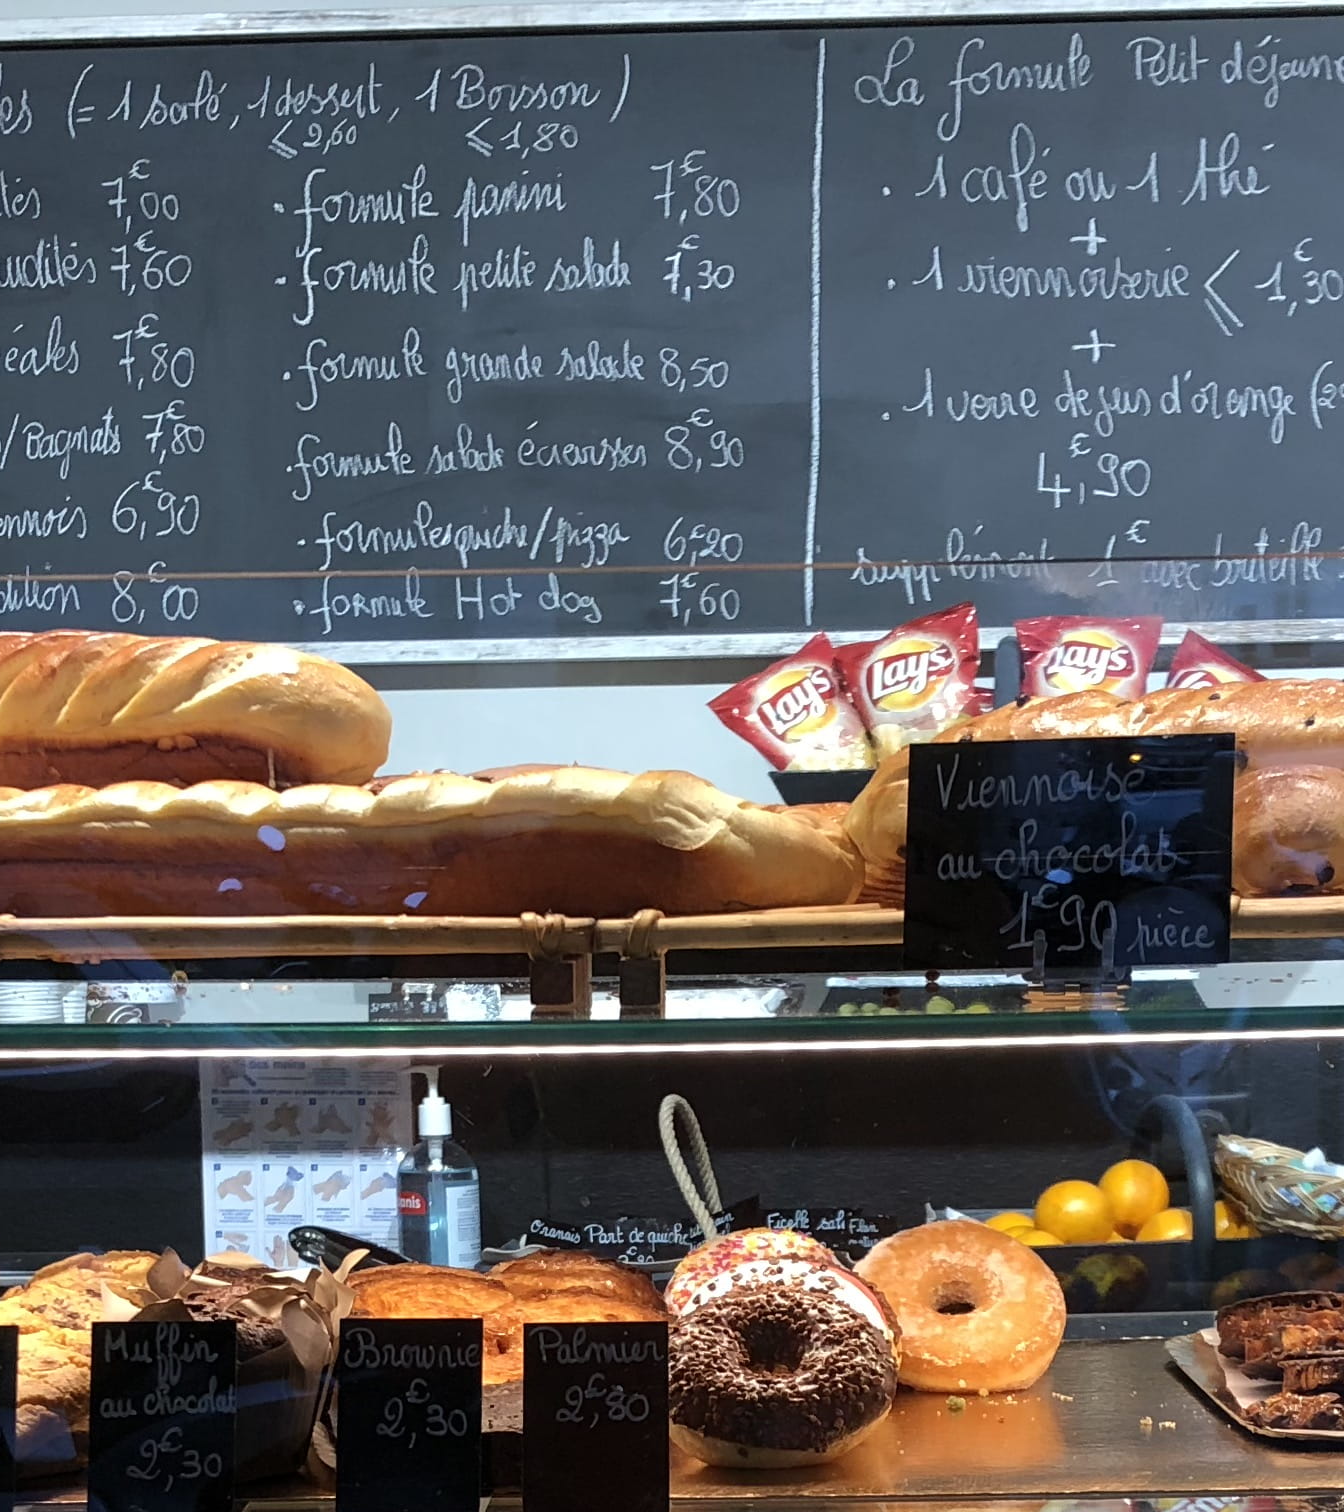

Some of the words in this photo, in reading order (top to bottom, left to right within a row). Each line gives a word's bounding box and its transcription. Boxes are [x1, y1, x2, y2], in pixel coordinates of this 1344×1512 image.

[856, 37, 924, 106] La
[936, 37, 1093, 141] formule
[1127, 36, 1209, 86] Petit
[294, 164, 439, 256] formule
[456, 174, 566, 246] panini
[962, 123, 1050, 232] café
[1066, 167, 1117, 200] ou
[1181, 131, 1274, 207] thé
[293, 234, 435, 325] formule
[454, 244, 536, 313] petite
[544, 235, 631, 291] salade
[297, 327, 428, 411] formule
[446, 345, 544, 404] grande
[555, 339, 644, 383] salade
[658, 348, 729, 394] 8,50
[946, 388, 1039, 422] verre
[292, 421, 415, 501] formule
[425, 423, 504, 474] salade
[309, 566, 435, 634] formule
[457, 578, 521, 620] Hot
[539, 575, 603, 623] dog
[937, 753, 1145, 810] Viennoise
[938, 852, 981, 880] au
[994, 813, 1178, 880] chocolat
[1127, 913, 1216, 961] pièce
[584, 1224, 626, 1245] Part
[629, 1227, 644, 1243] de
[105, 1322, 219, 1386] Muffin
[344, 1329, 480, 1369] Brownie
[529, 1328, 663, 1364] Palmier
[100, 1400, 138, 1417] au
[143, 1377, 237, 1418] chocolat
